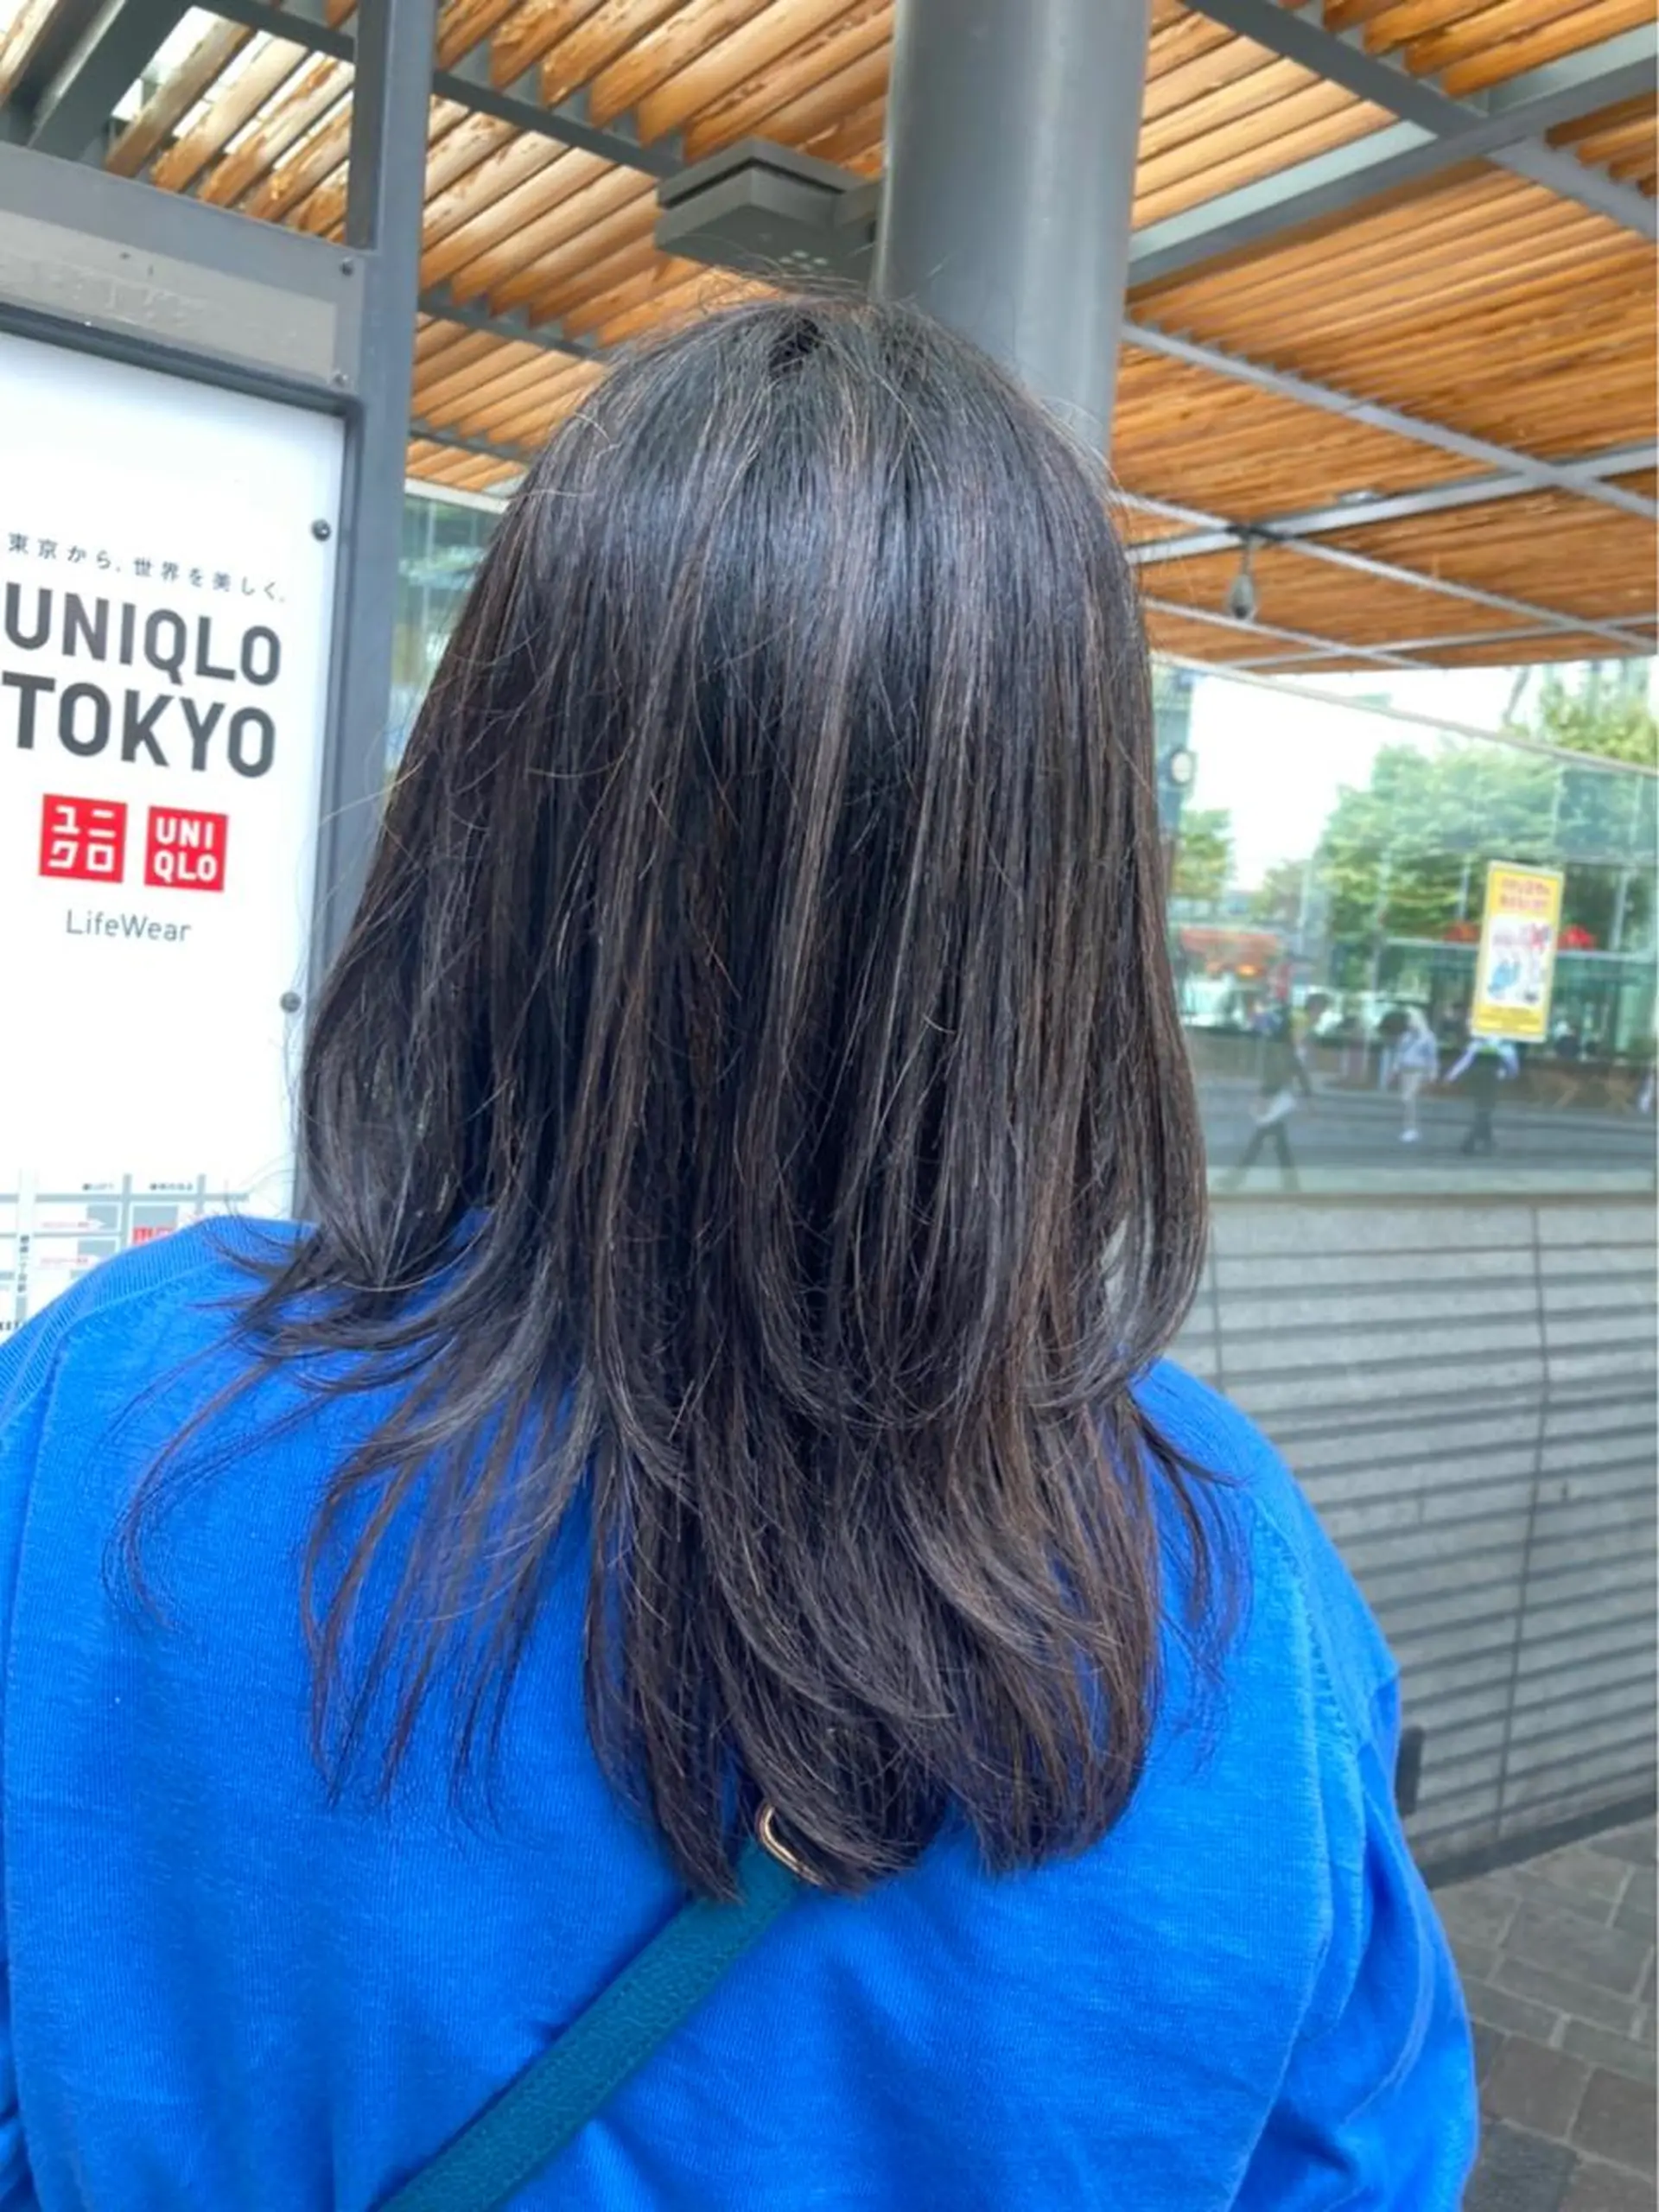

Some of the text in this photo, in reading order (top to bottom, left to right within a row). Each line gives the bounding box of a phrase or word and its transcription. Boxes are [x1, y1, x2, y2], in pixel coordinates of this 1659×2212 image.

[4, 582, 281, 687] UNIQLO
[2, 671, 276, 779] TOKYO
[156, 817, 214, 849] UNI
[153, 849, 218, 883] QLO
[66, 909, 192, 942] LifeWear
